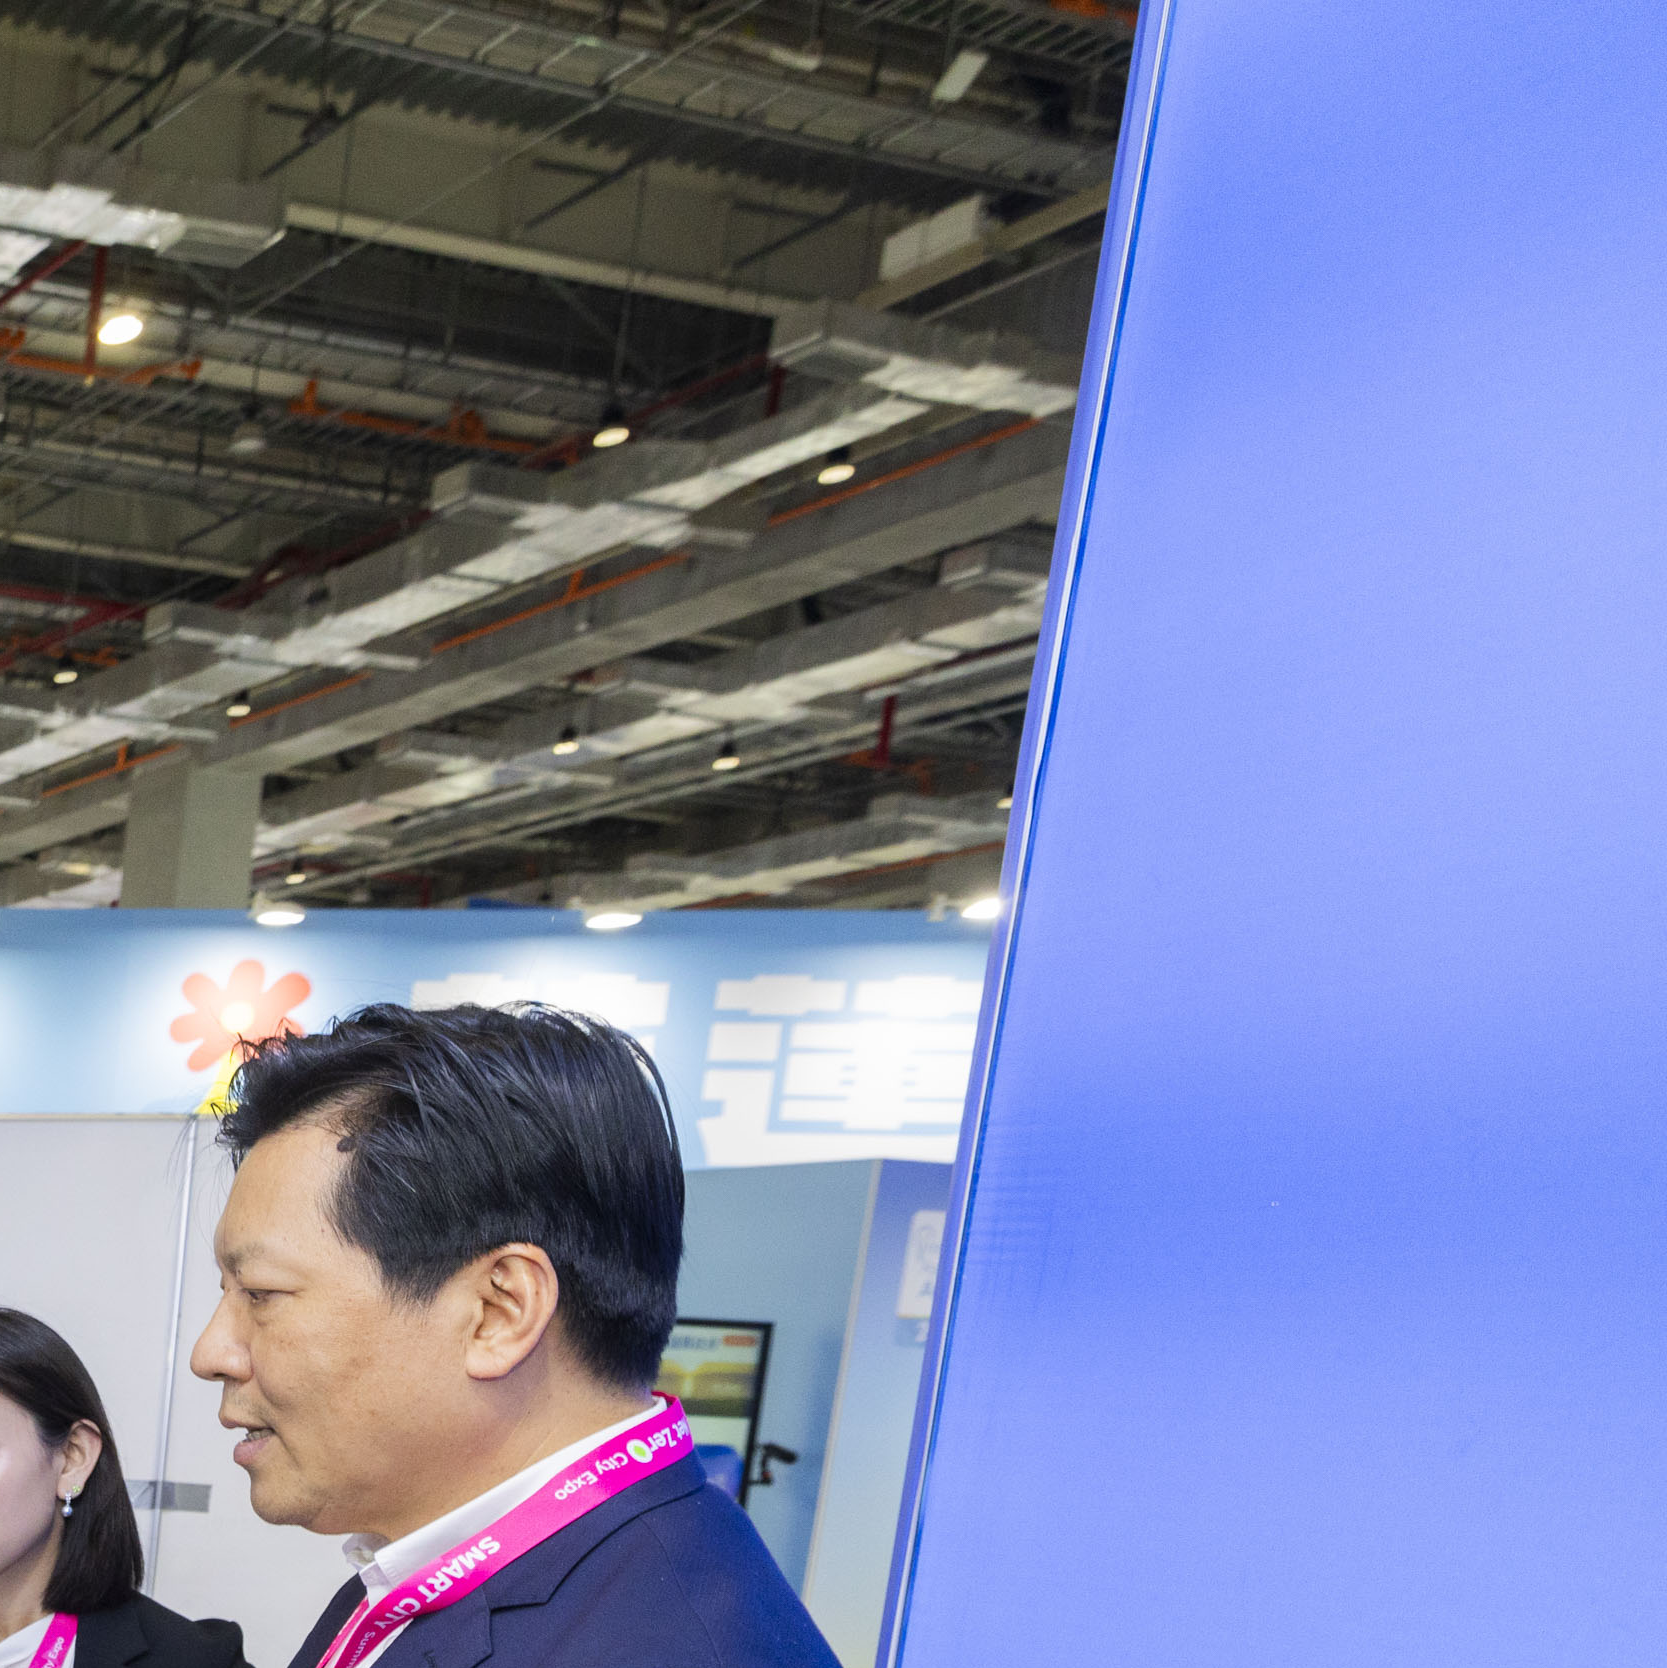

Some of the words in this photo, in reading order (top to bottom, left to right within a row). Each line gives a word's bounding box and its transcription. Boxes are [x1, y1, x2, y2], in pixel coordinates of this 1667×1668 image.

[594, 1449, 630, 1483] City
[552, 1466, 599, 1502] Expo
[419, 1535, 502, 1604] SMART
[47, 1636, 65, 1661] Expo
